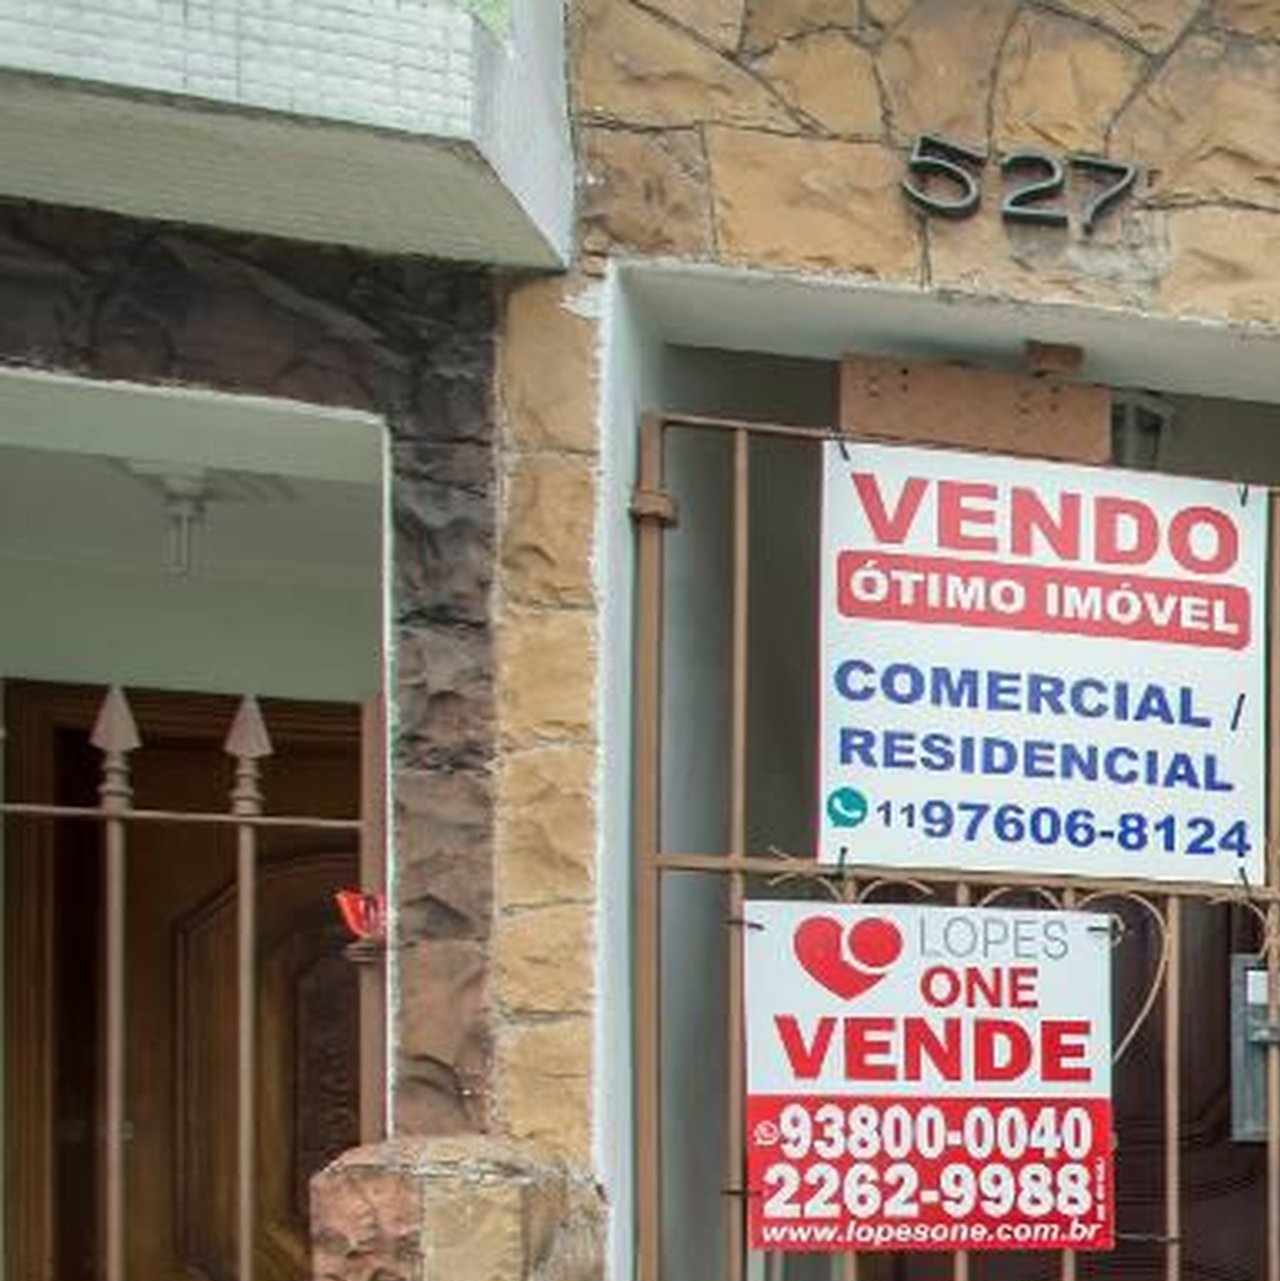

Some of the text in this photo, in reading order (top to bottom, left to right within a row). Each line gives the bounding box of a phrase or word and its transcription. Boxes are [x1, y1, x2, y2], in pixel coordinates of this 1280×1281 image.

[902, 134, 1137, 236] 527
[850, 471, 1240, 575] VENDO
[849, 559, 1240, 634] ÓTIMO IMÓVEL
[833, 659, 1212, 728] COMERCIAL
[838, 726, 1235, 792] RESIDENCIAL
[919, 915, 1069, 961] LOPES
[919, 964, 1039, 1009] ONE
[773, 1013, 1093, 1083] VENDE
[778, 1103, 1093, 1159] 93800-0040
[762, 1162, 1093, 1219] 2262-9988
[761, 1219, 1104, 1243] www.lopesone.com.br
